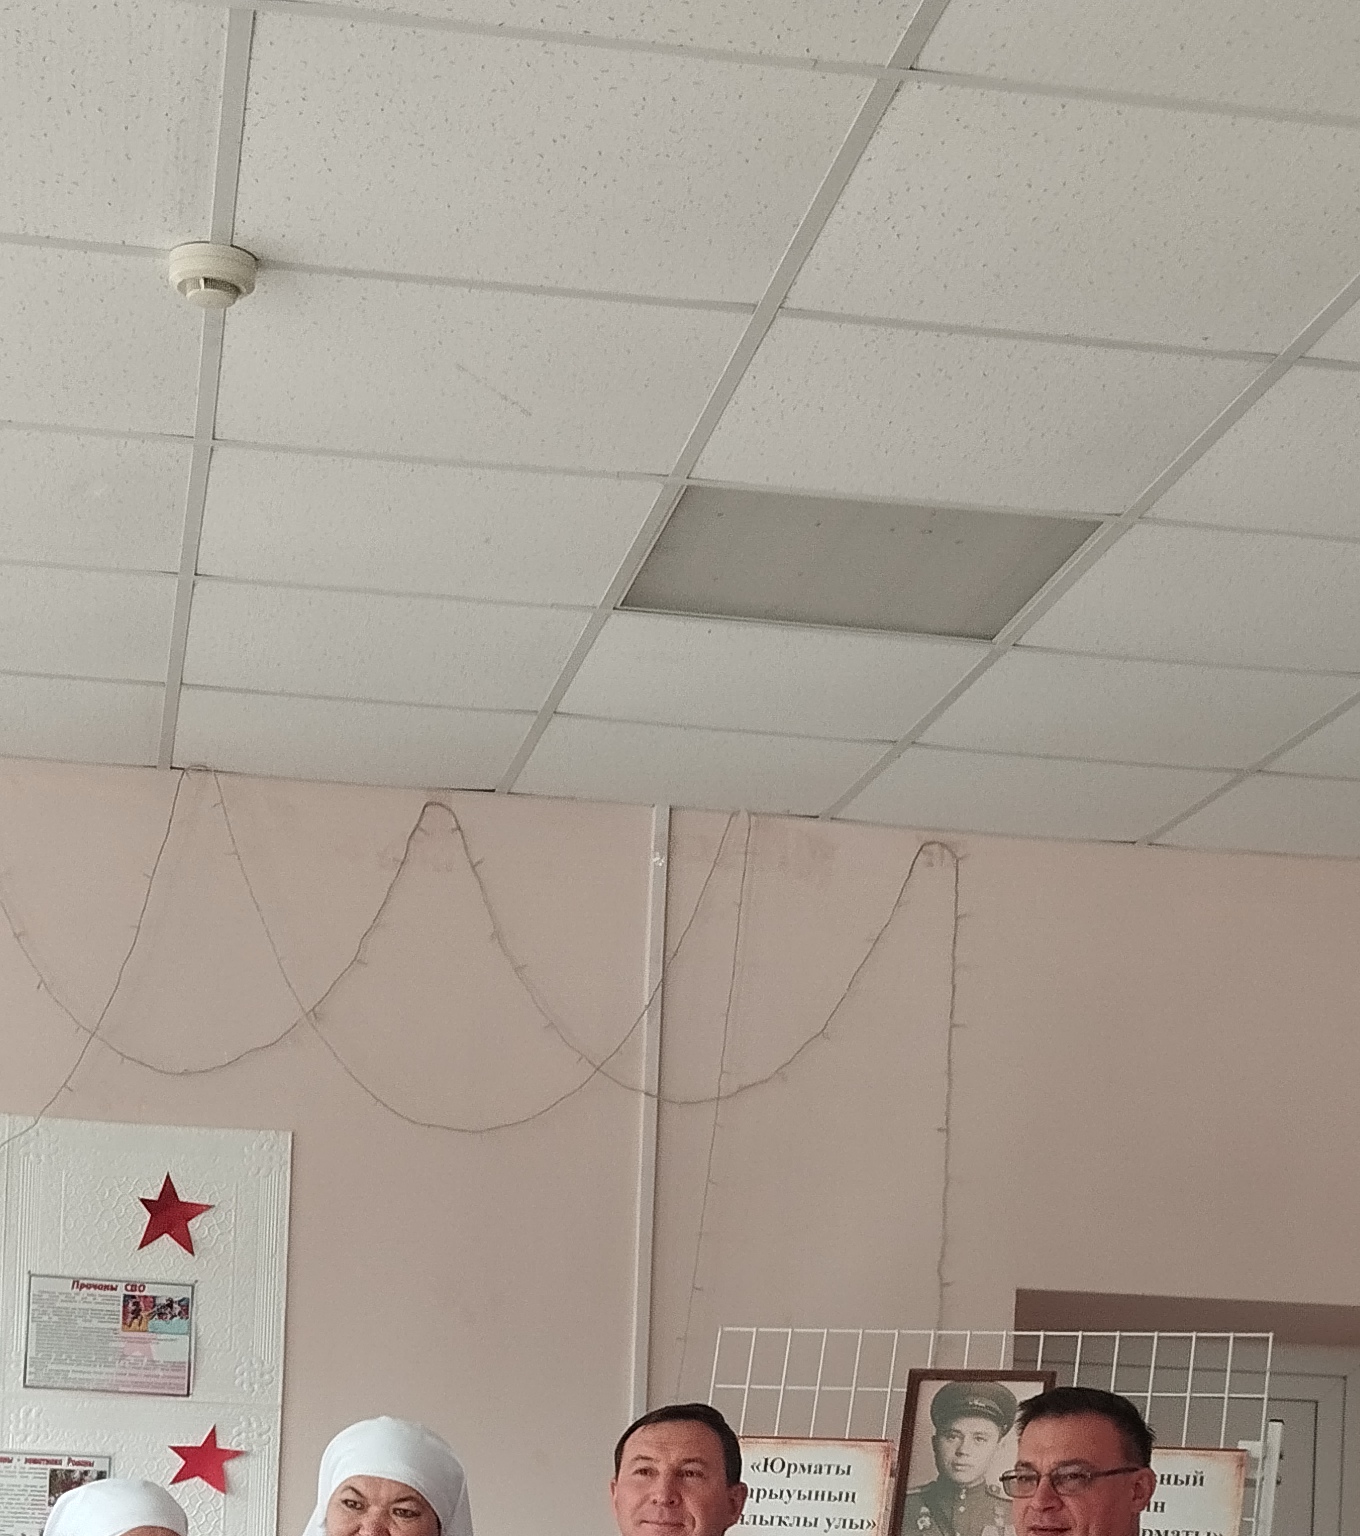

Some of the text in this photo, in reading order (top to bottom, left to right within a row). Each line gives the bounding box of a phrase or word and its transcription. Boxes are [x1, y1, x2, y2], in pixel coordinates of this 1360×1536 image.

[750, 1457, 851, 1478] «Юрматы
[1158, 1470, 1205, 1487] ный
[824, 1517, 877, 1533] улы»
